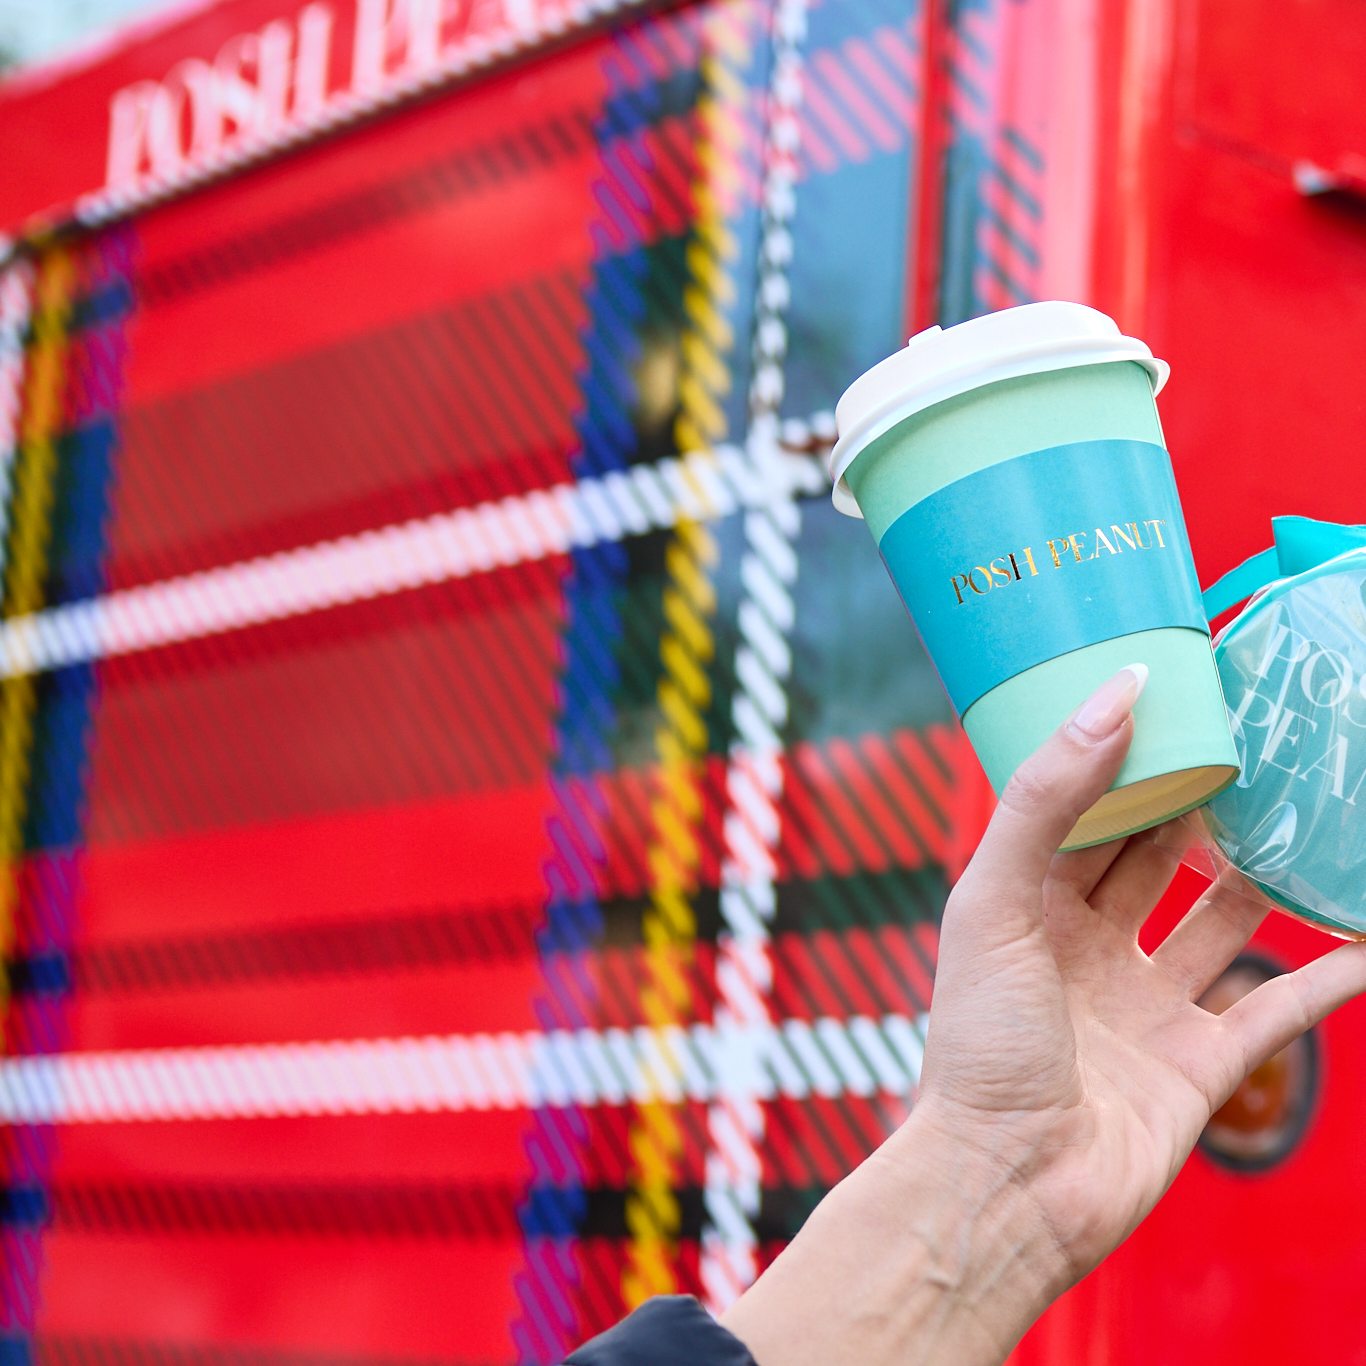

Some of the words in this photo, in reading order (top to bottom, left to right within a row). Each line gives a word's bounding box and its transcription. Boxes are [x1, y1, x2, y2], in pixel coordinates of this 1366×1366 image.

[105, 1, 334, 197] POSH
[949, 547, 1038, 604] POSH
[1046, 519, 1166, 568] PEANUT
